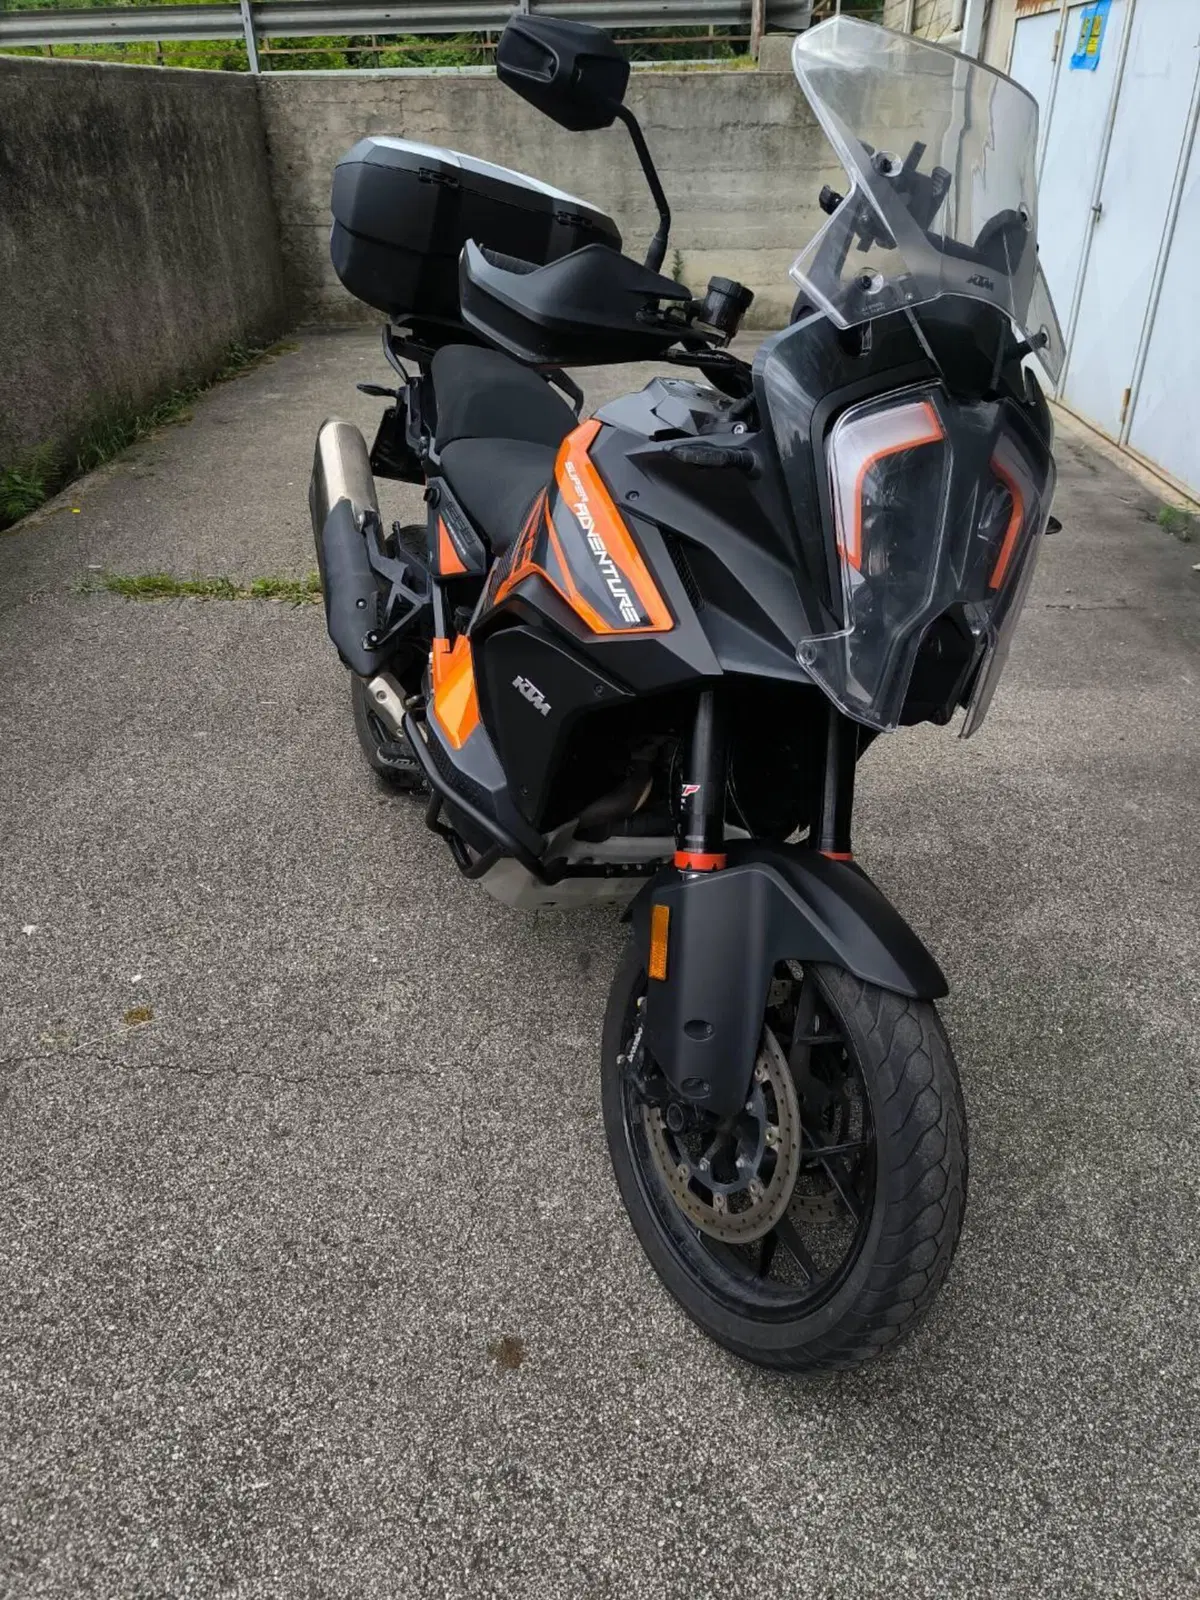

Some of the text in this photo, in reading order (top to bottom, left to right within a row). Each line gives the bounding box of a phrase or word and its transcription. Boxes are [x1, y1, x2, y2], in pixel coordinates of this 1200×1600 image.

[966, 273, 994, 291] KTM
[565, 461, 641, 622] SUPER ADVENTURE
[512, 675, 552, 717] KTM
